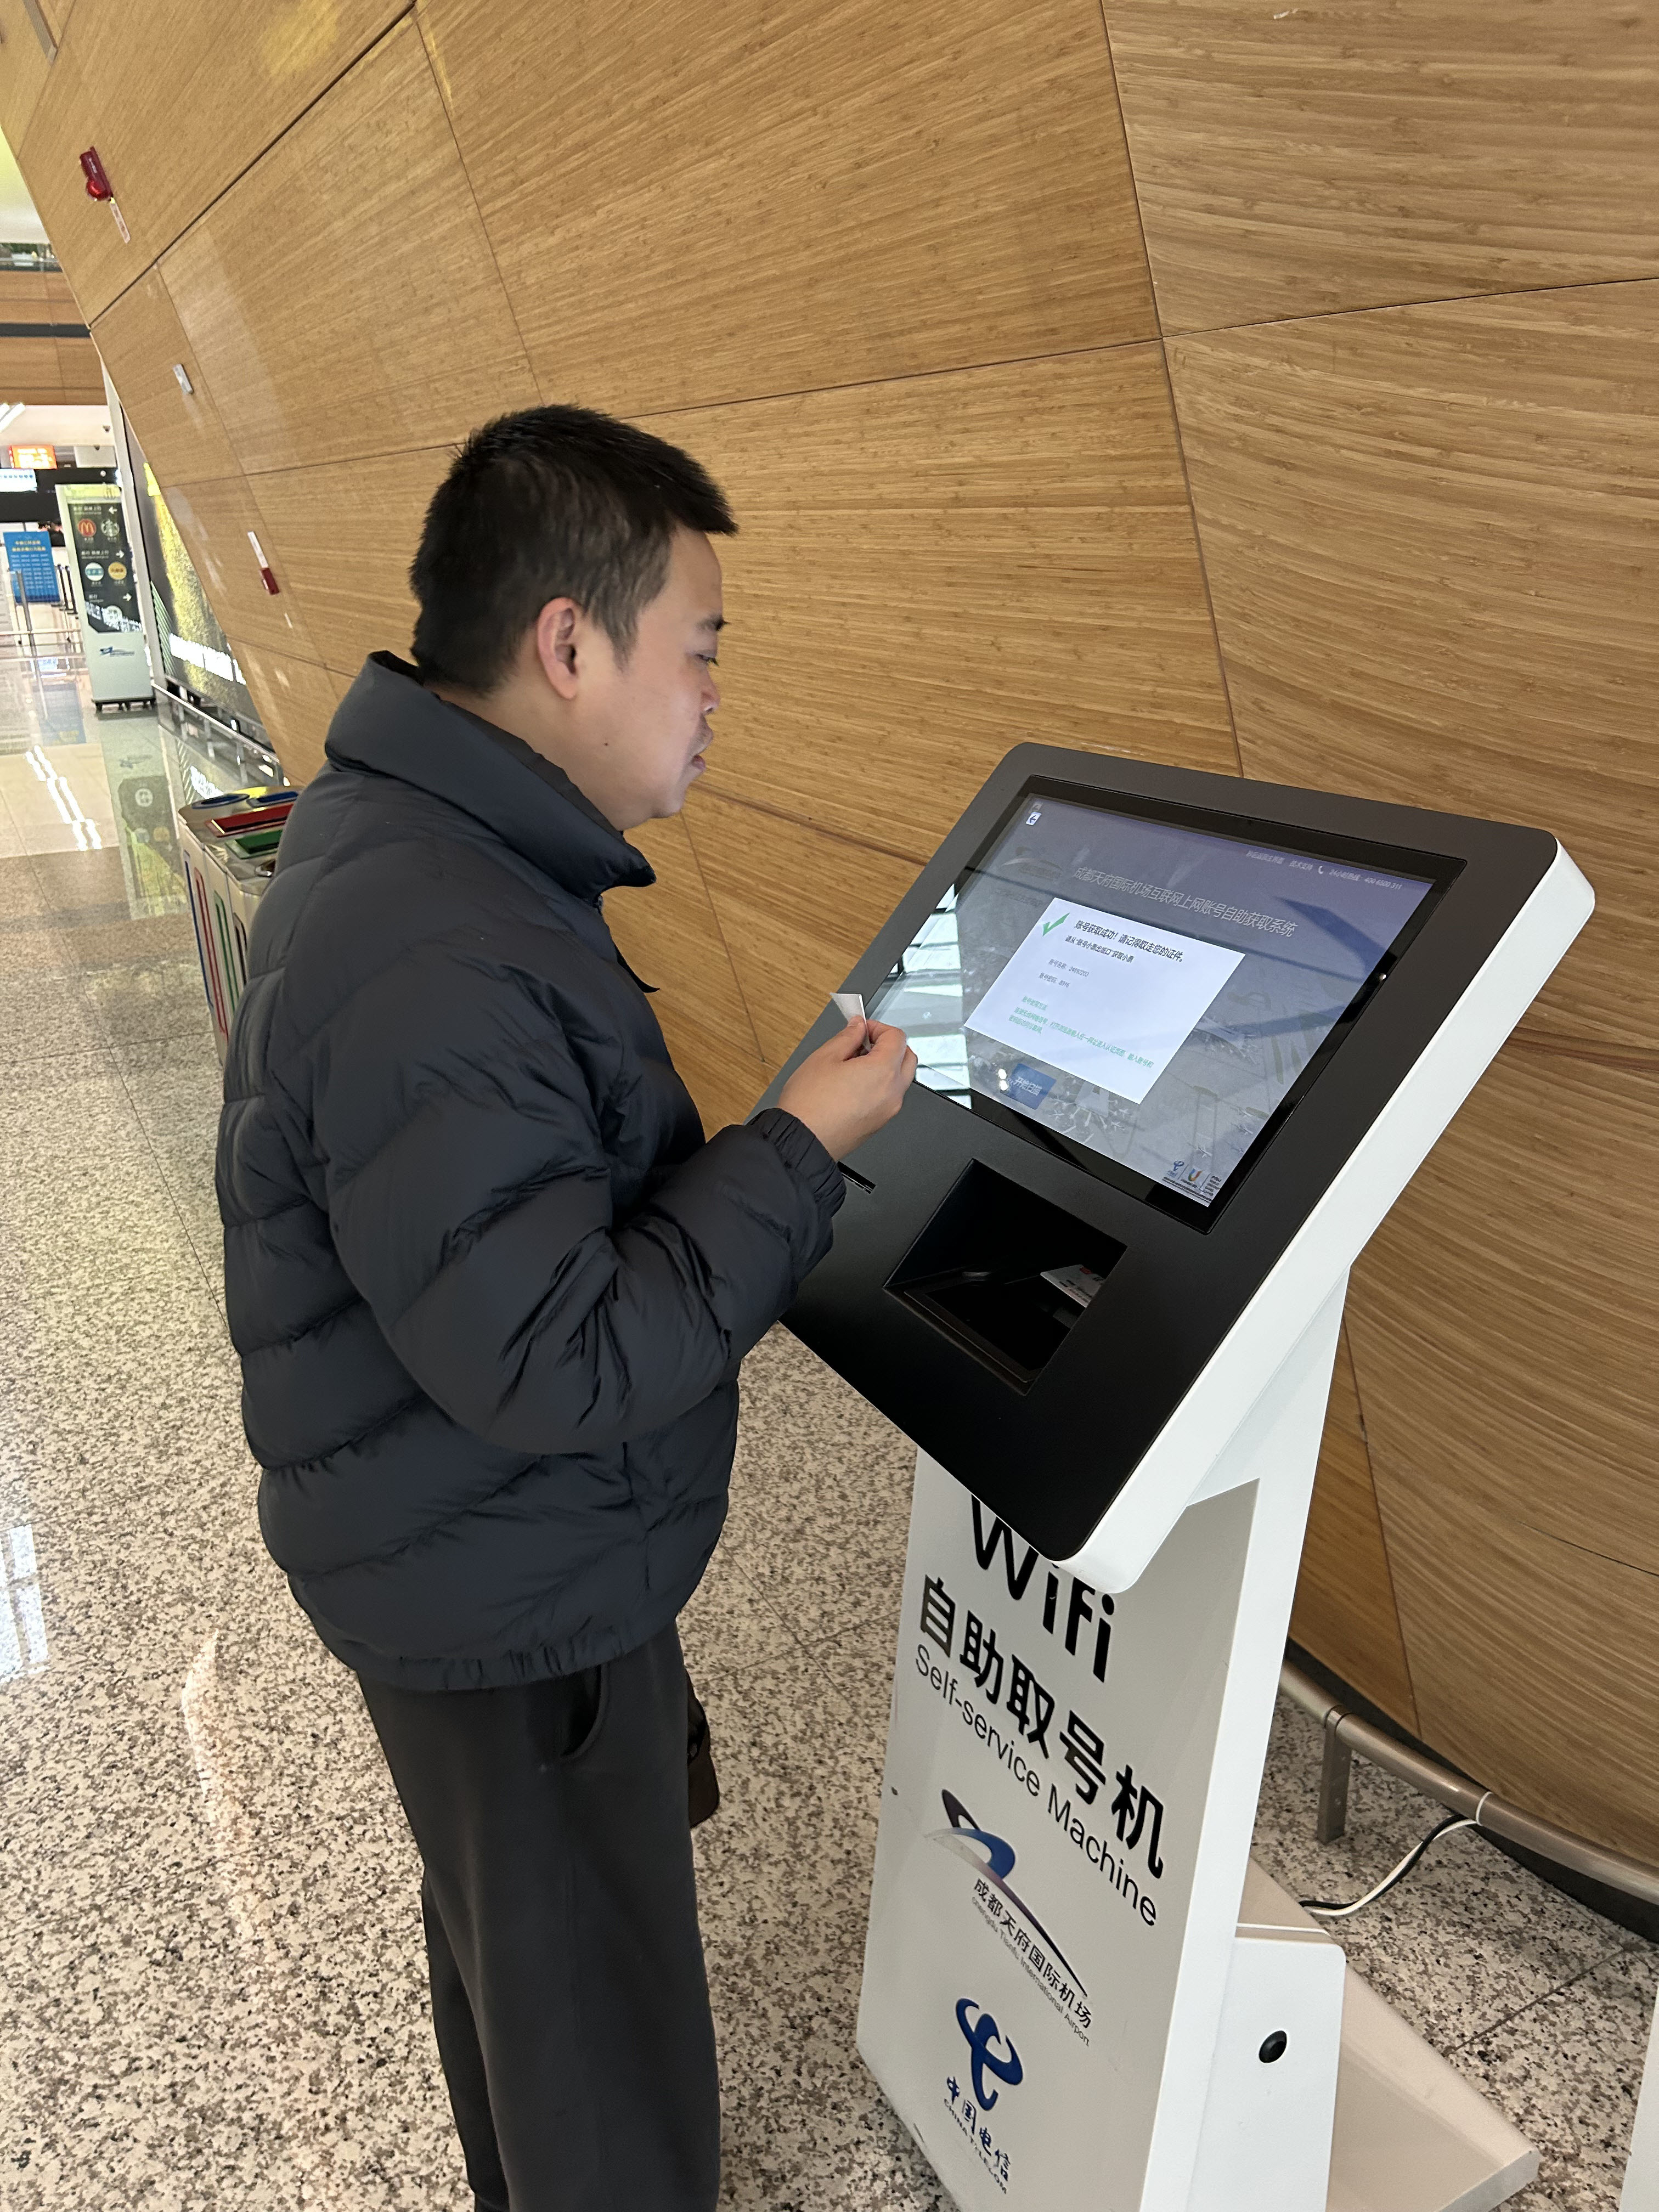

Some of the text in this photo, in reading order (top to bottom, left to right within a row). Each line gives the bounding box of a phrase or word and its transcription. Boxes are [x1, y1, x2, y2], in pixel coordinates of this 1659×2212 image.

[1073, 867, 1299, 938] 成都天府国际机场互联网上网账号自助获取系统
[1289, 860, 1313, 871] 技术支持
[1014, 1076, 1043, 1096] 开始扫描
[972, 1494, 1115, 1683] Wifi
[919, 1575, 1164, 1880] 自助取号机
[915, 1645, 1157, 1927] Self-service Machine
[974, 1878, 1092, 2029] 成都天府国际机场
[1020, 1956, 1064, 2013] International
[944, 2098, 968, 2136] CHINA
[946, 2076, 1011, 2182] 中国电信
